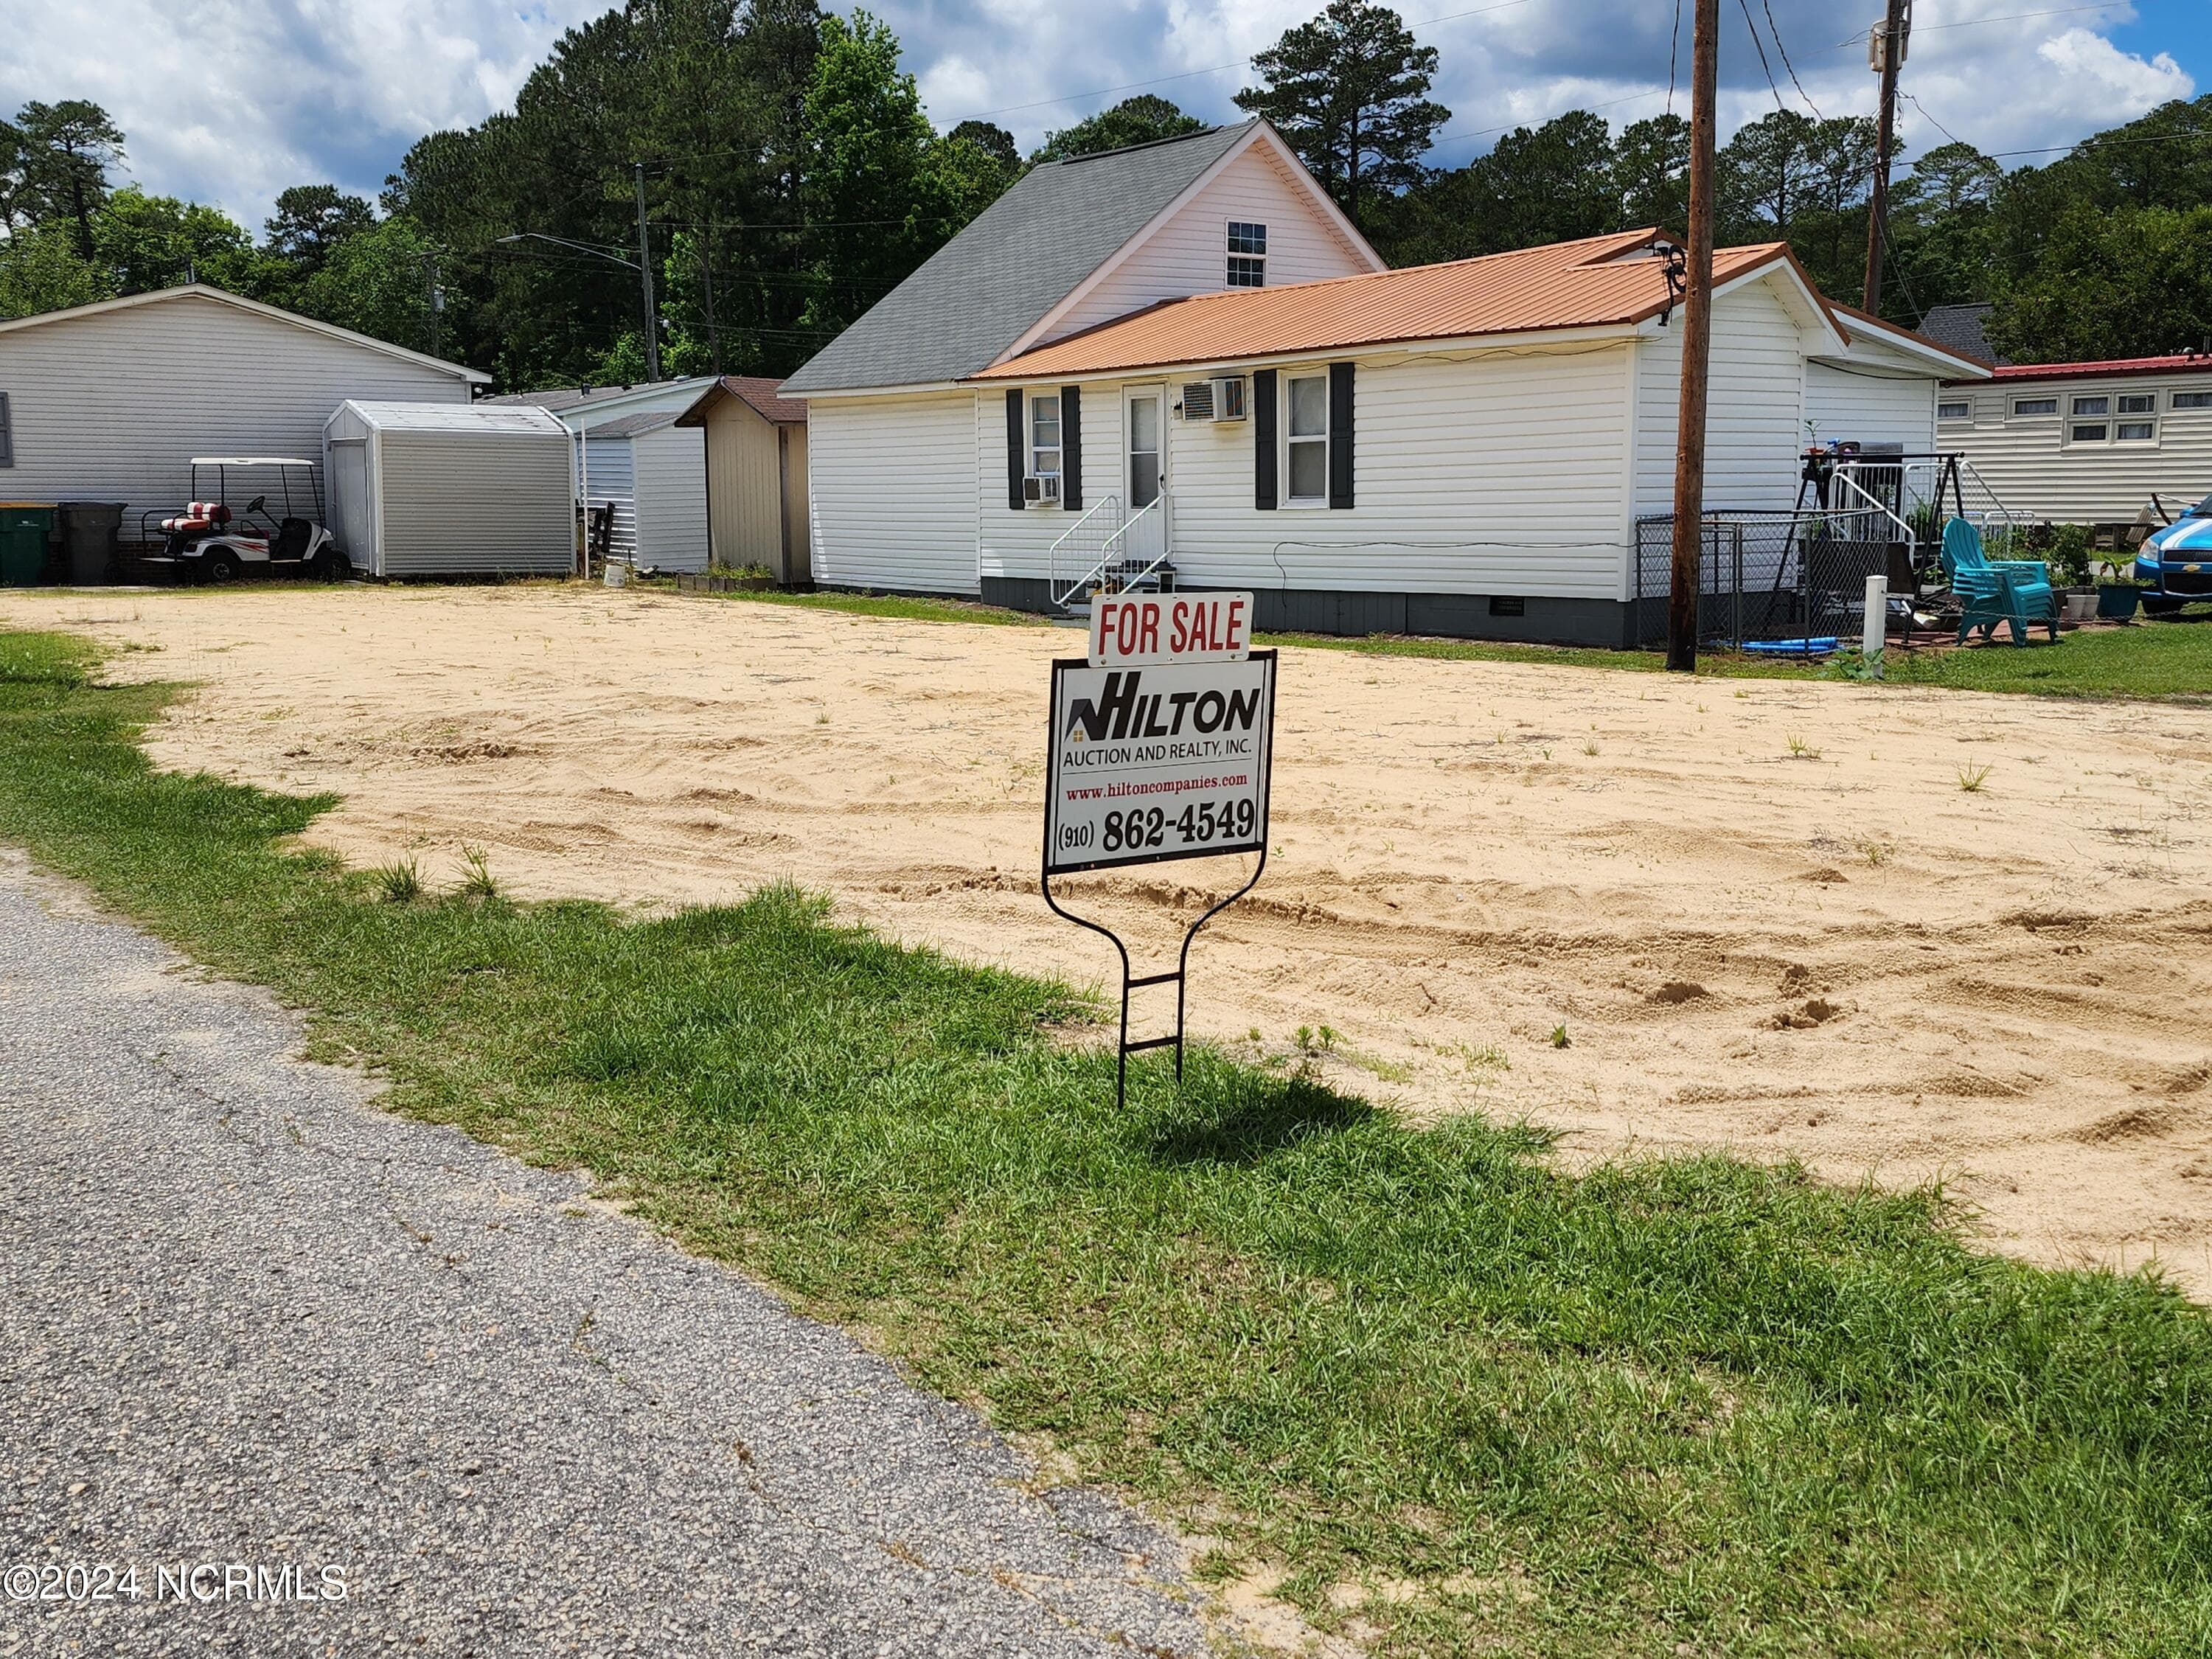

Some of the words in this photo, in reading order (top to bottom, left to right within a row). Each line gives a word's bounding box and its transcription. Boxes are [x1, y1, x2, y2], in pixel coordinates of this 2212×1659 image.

[1098, 602, 1160, 655] FOR
[1170, 600, 1245, 653] SALE
[1094, 672, 1260, 740] HILTON
[1063, 747, 1130, 768] AUCTION
[1135, 745, 1166, 762] AND
[1169, 740, 1222, 759] REALTY,
[1225, 738, 1252, 754] INC.
[1066, 774, 1248, 801] www.hiltoncompanies.com
[1059, 819, 1094, 851] (910)
[1102, 798, 1255, 852] 862-4549
